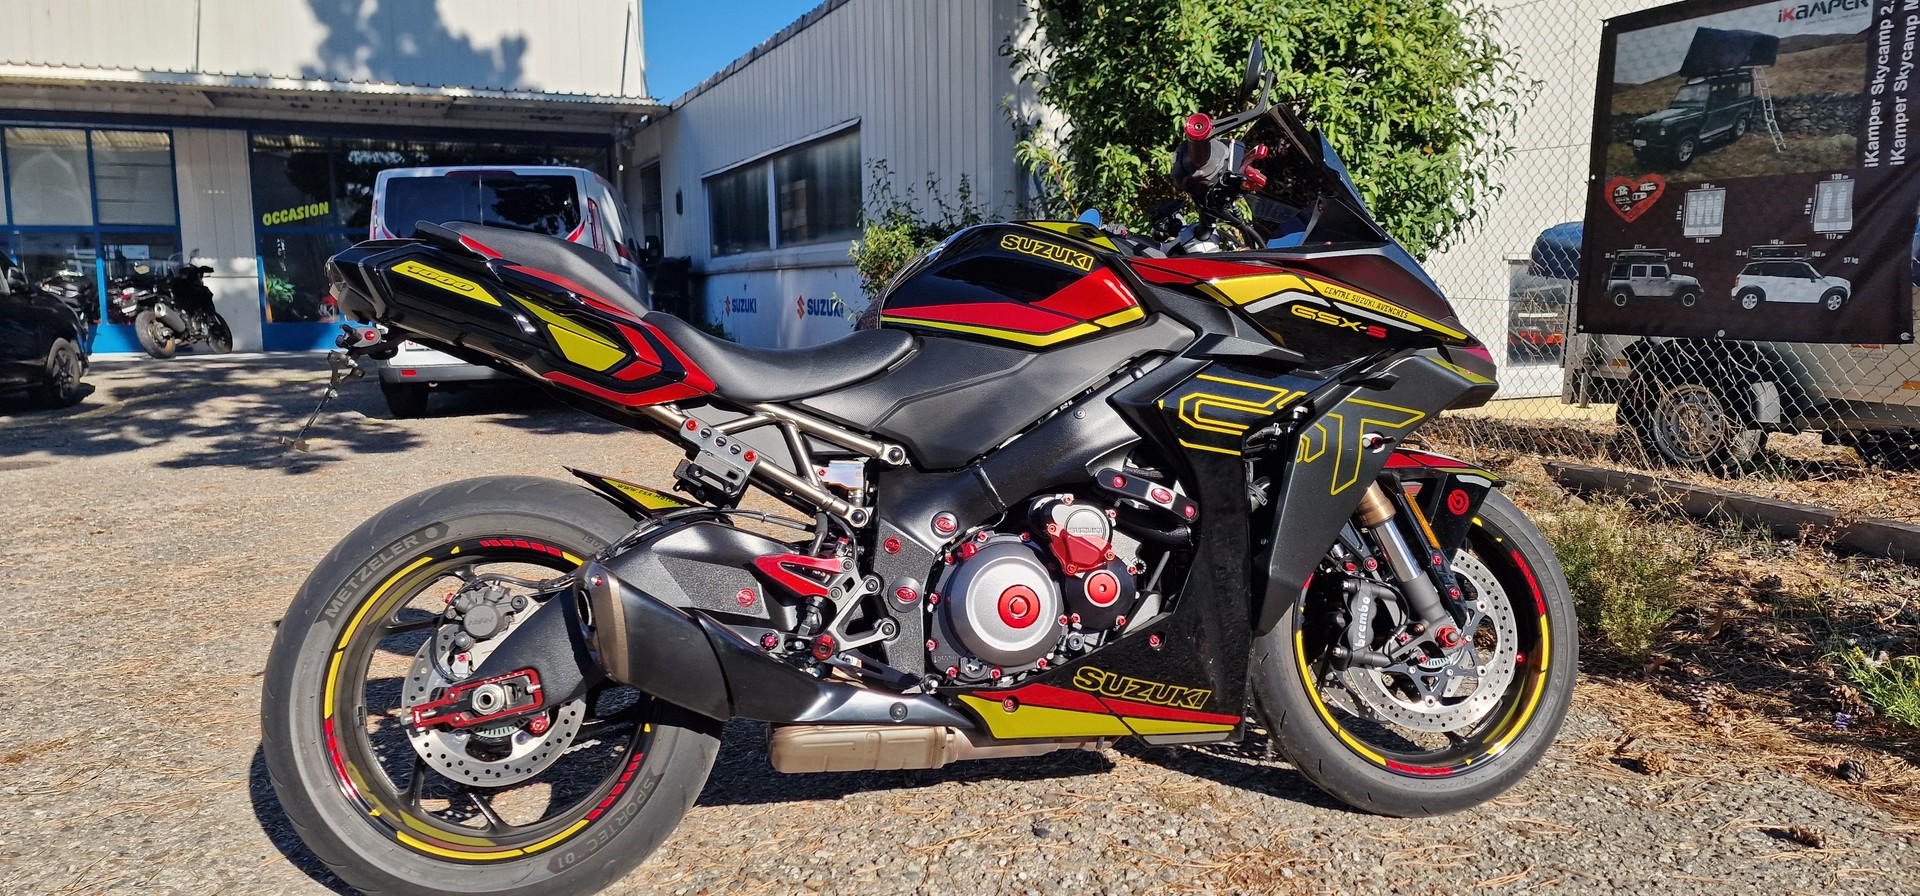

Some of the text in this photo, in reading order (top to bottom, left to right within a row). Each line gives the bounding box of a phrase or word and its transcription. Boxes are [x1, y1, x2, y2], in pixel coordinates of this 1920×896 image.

[1893, 14, 1920, 93] Skycamp
[1864, 0, 1895, 168] iKamper Skycamp 2.
[1889, 96, 1909, 166] iKamper
[262, 201, 329, 226] OCCASION
[1000, 234, 1094, 272] SUZUKI
[407, 265, 475, 292] 1000
[731, 298, 757, 313] SUZUKI
[806, 298, 844, 318] SUZUKI
[1290, 304, 1387, 338] GSX-S
[1323, 286, 1409, 319] CENTRE SUZUKI AVENCHES
[324, 535, 420, 618] METZELER
[1354, 596, 1371, 648] brembo
[1073, 665, 1212, 710] SUZUKI
[586, 777, 656, 853] SPORTEC
